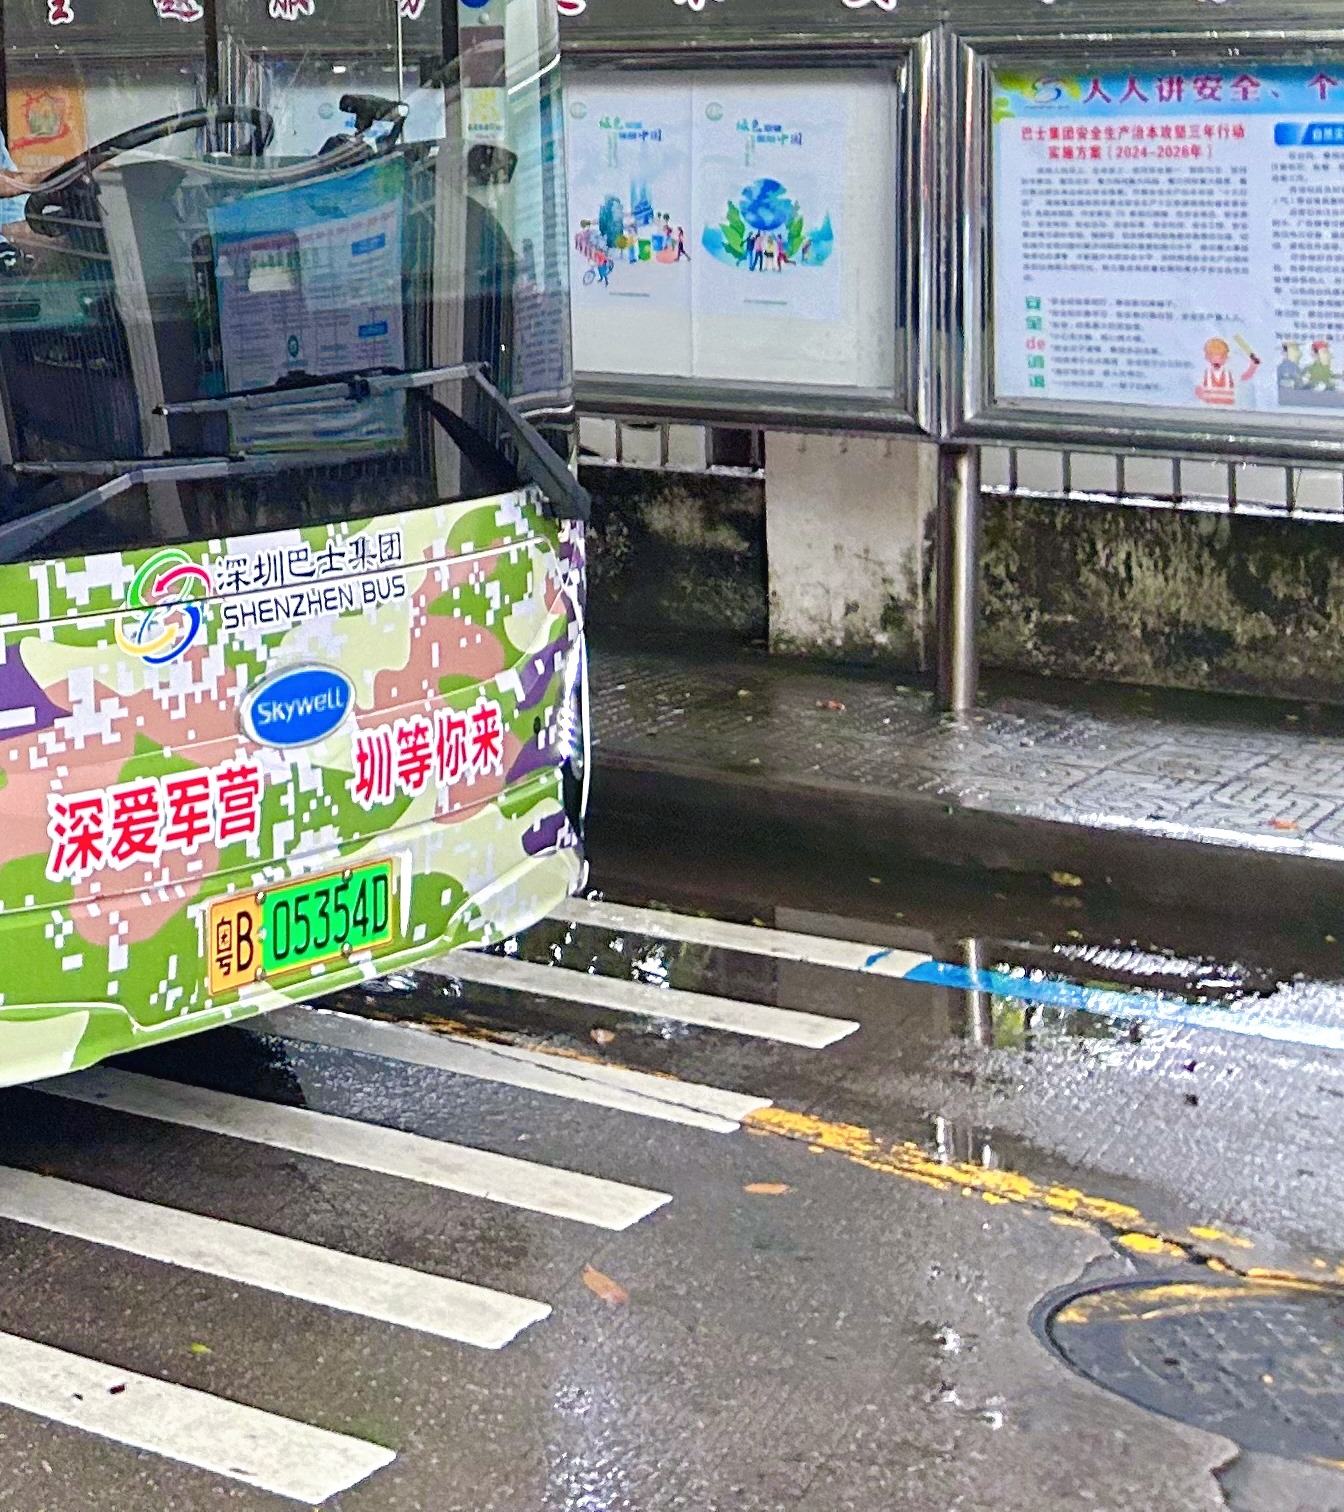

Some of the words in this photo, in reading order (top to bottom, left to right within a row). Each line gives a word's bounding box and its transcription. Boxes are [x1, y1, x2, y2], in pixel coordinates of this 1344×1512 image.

[216, 530, 403, 595] 深圳巴士集团
[223, 583, 355, 631] SHENZHEN
[362, 573, 406, 605] BUS
[50, 762, 262, 876] 深爱军营
[354, 700, 505, 804] 圳等你来
[215, 910, 255, 977] 粤B
[272, 873, 390, 961] 05354D
